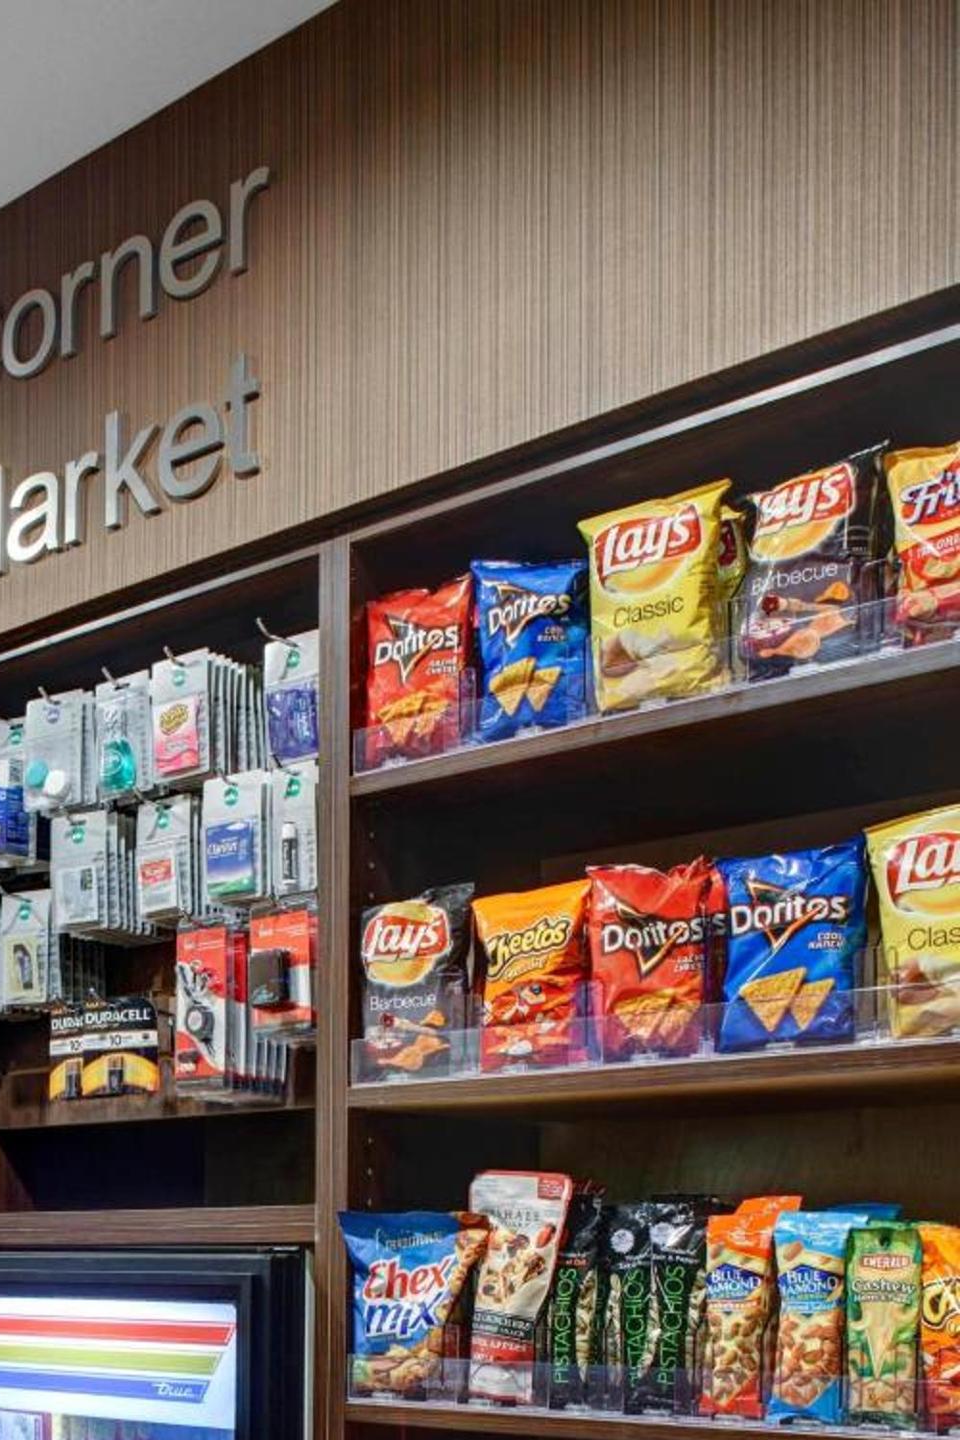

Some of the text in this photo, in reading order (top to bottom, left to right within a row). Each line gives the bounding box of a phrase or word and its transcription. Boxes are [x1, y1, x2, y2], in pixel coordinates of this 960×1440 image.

[602, 511, 696, 577] Lay's
[488, 593, 572, 638] Doritos
[613, 596, 684, 629] Classic
[374, 621, 460, 667] Doritos
[601, 917, 704, 953] Doritos
[730, 894, 848, 936] Doritos
[487, 916, 571, 978] Cheetos
[85, 1007, 151, 1026] DURACELL
[364, 1258, 450, 1300] Chex
[851, 1278, 915, 1295] Cashew
[553, 1267, 577, 1384] PISTACHIOS
[656, 1264, 685, 1385] PISTACHIOS
